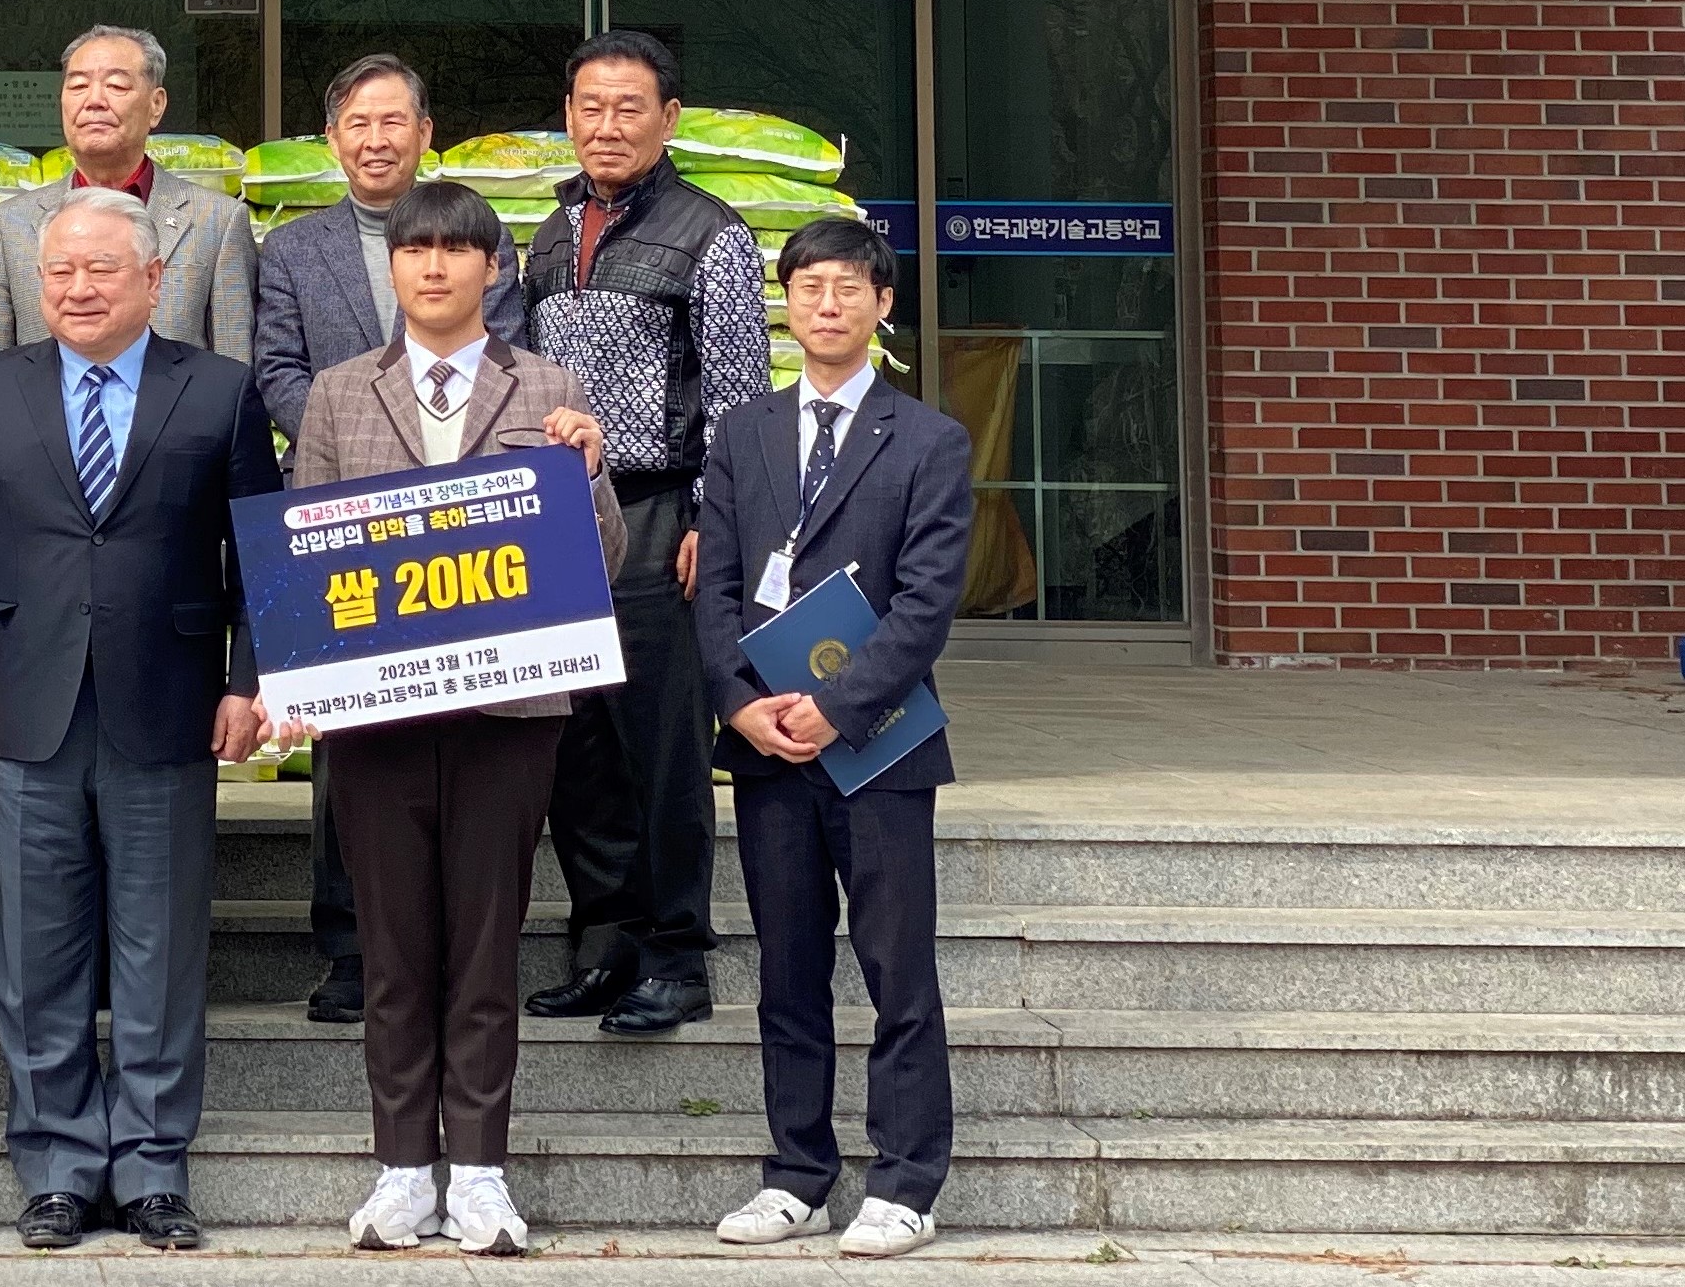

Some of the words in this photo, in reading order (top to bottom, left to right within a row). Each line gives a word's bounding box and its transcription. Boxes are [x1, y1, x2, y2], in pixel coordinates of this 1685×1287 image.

[972, 217, 1162, 241] 한국과학기술고등학교
[297, 501, 371, 524] 개교51주년
[374, 491, 416, 509] 기념식
[419, 487, 433, 503] 및
[435, 480, 478, 501] 장학금
[482, 471, 524, 491] 수여식
[288, 525, 364, 556] 신입생의
[367, 514, 426, 543] 입학을
[428, 494, 542, 531] 축하드립니다
[324, 569, 379, 630] 쌀
[394, 544, 529, 617] 20KG
[378, 662, 431, 682] 2023년
[436, 654, 461, 671] 3월
[465, 647, 500, 665] 17일
[286, 681, 438, 720] 한국과학기술고등학교
[443, 676, 458, 694] 총
[462, 669, 509, 691] 동문회
